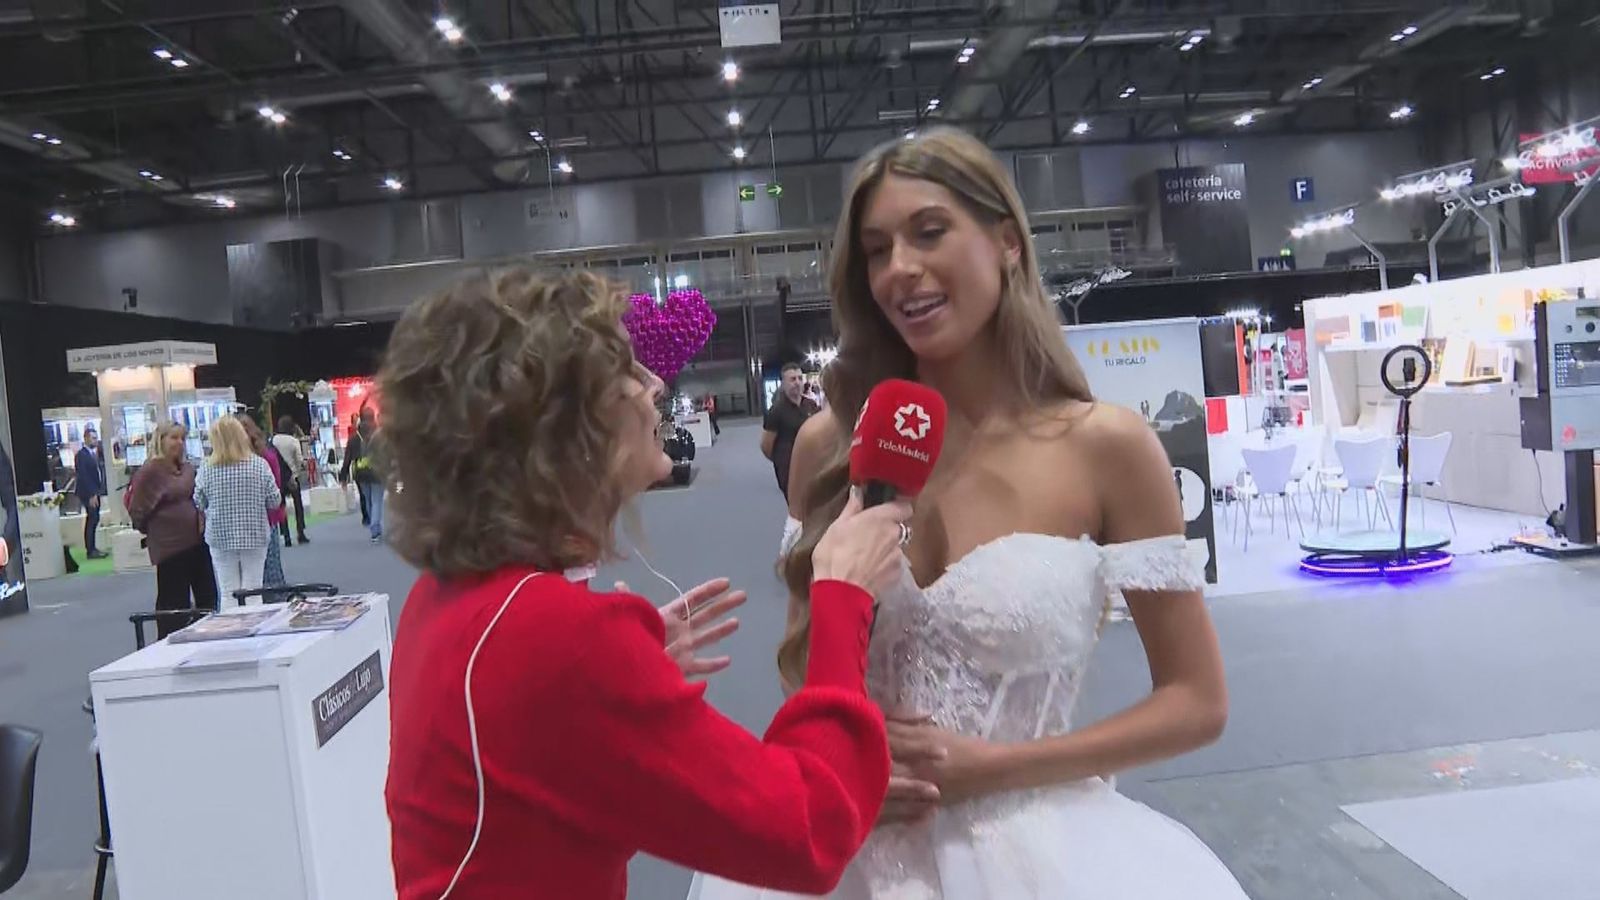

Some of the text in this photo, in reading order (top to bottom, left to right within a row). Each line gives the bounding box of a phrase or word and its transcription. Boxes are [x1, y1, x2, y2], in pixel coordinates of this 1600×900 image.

[1166, 188, 1242, 203] self-service
[1295, 181, 1307, 199] F
[1115, 356, 1146, 365] REGALO
[877, 439, 930, 462] TeleMadrid
[319, 685, 351, 721] Clásicos
[355, 666, 371, 691] Lujo
